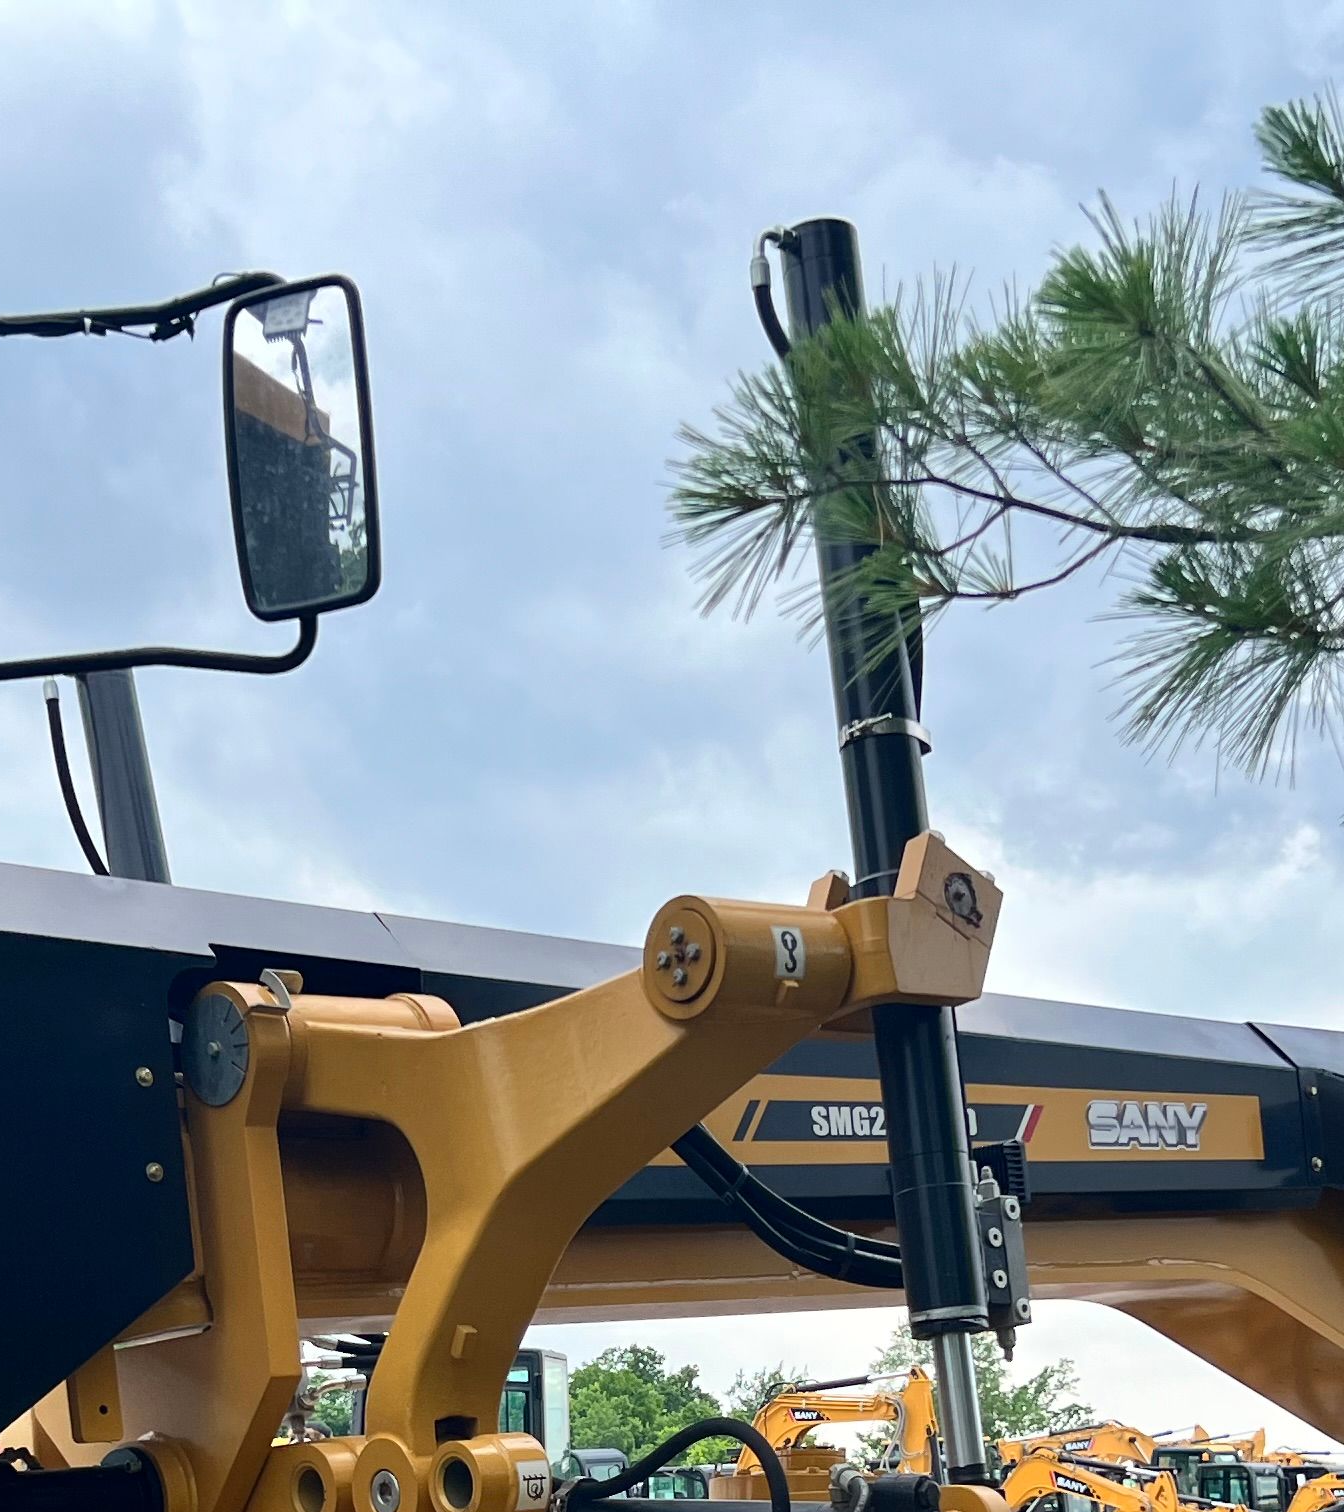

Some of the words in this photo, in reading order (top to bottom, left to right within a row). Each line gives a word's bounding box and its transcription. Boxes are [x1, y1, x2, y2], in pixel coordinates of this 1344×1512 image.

[1086, 1100, 1207, 1151] SANY
[794, 1411, 818, 1420] SANY
[1065, 1440, 1090, 1451] SANY
[1057, 1476, 1087, 1493] SANY
